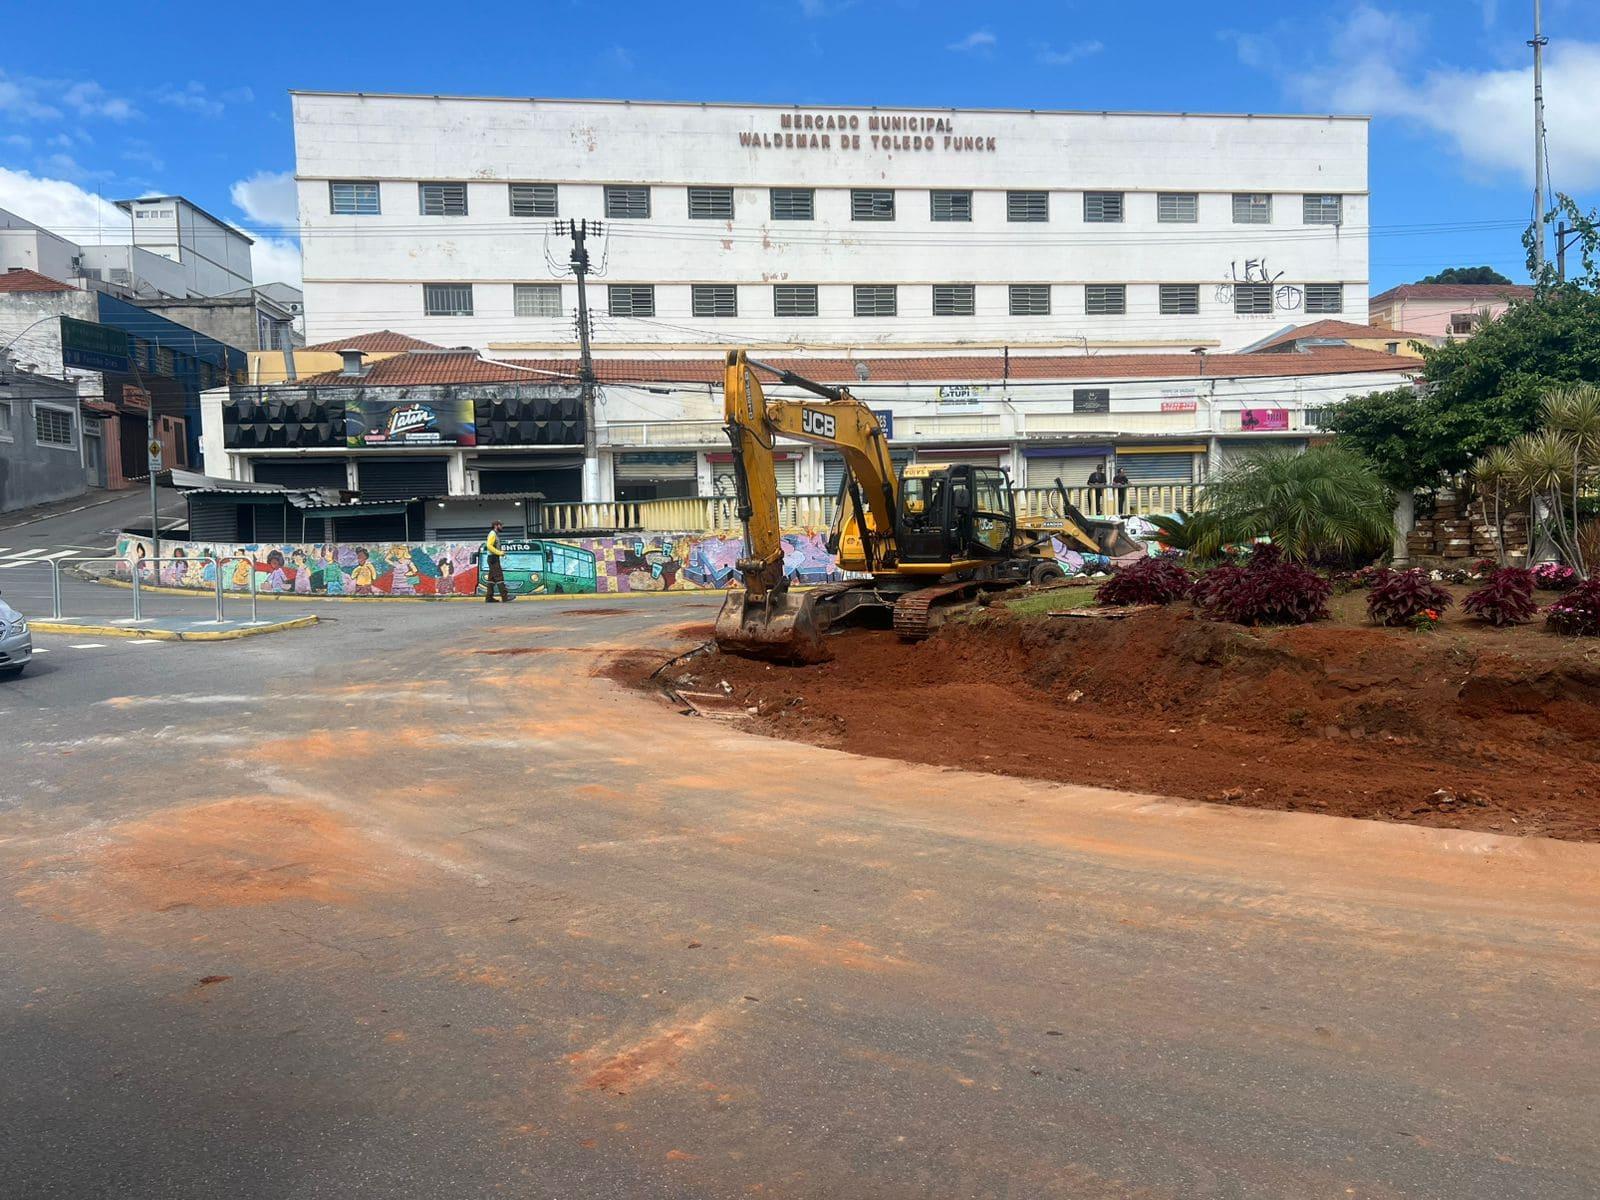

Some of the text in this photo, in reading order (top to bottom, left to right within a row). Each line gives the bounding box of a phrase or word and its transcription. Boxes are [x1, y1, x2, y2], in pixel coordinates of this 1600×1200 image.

[780, 113, 953, 133] MERCADO MUNICIPAL
[738, 131, 997, 152] WALDEMAR DE TOLEDO FUNCK
[390, 403, 435, 435] Latin
[802, 409, 835, 438] JCB
[501, 543, 531, 552] ENTRO
